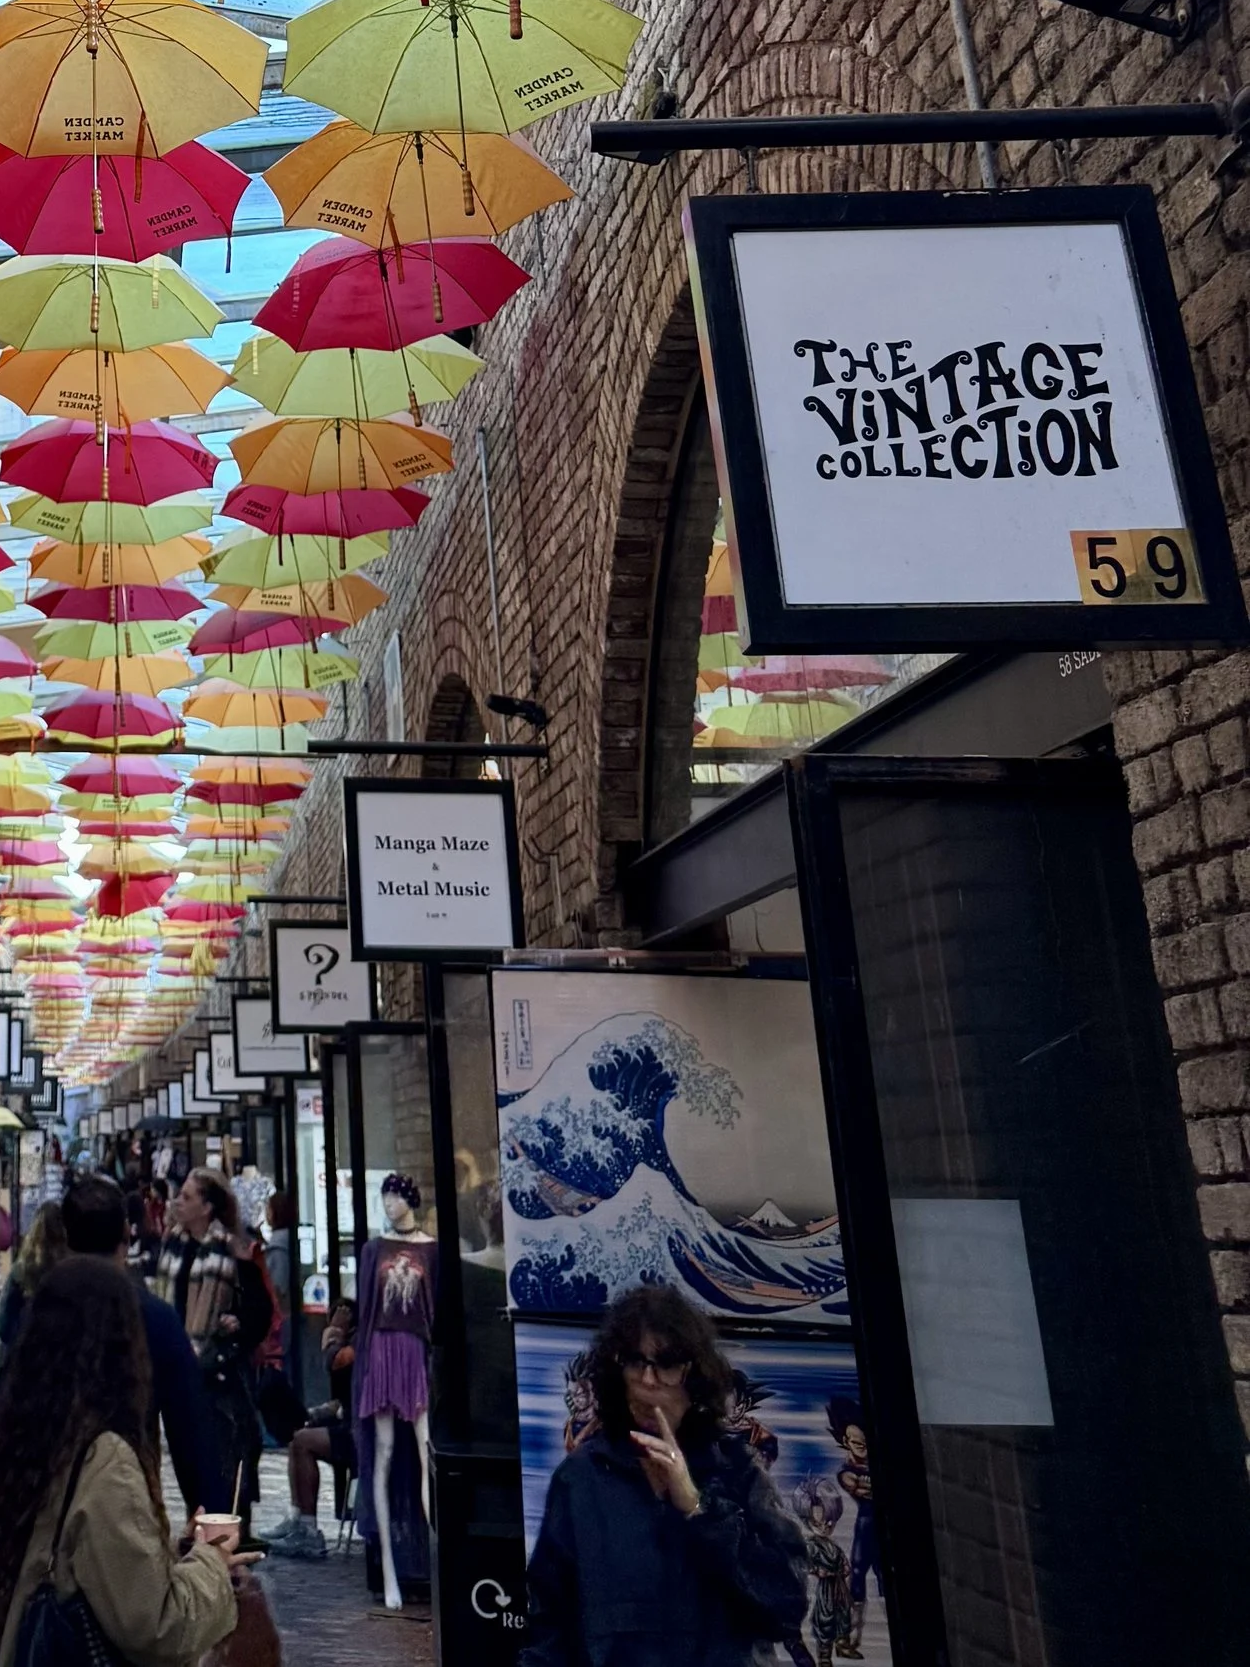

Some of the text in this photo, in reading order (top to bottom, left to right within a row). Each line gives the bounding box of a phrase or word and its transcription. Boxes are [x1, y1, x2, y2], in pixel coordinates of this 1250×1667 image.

[793, 338, 917, 388] THE
[1058, 654, 1072, 678] 58
[375, 835, 490, 854] Manga Maze
[432, 862, 440, 871] &
[377, 880, 491, 897] Metal Music
[502, 1611, 525, 1630] Re
